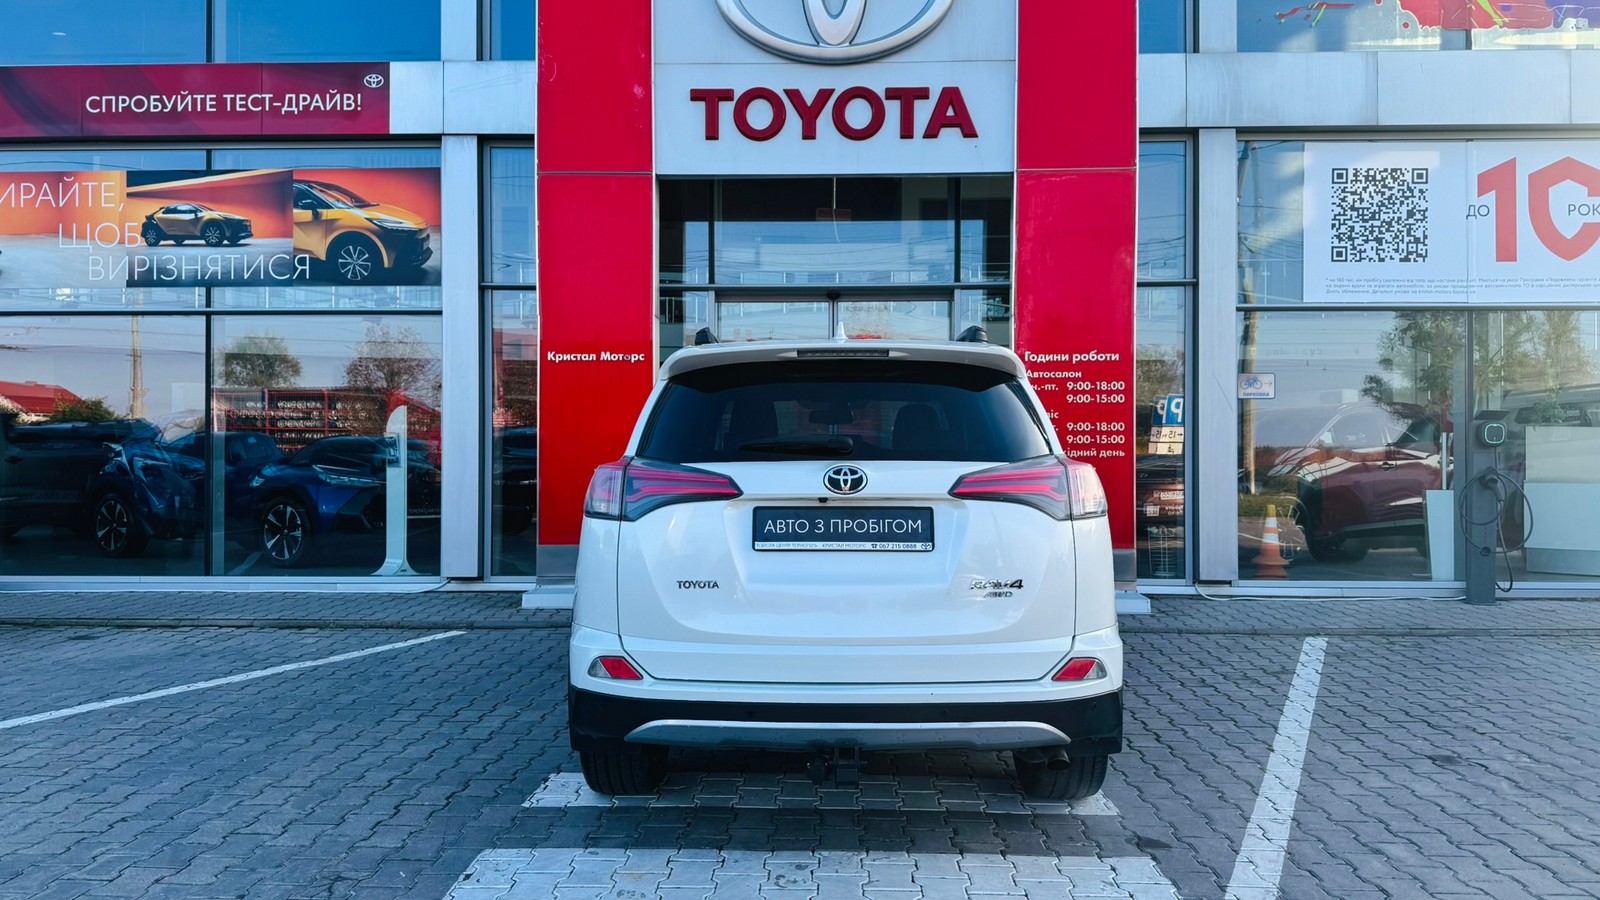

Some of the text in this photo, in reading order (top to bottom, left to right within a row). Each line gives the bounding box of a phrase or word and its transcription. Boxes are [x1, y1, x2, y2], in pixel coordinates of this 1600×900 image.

[85, 89, 362, 115] СПРОБУЙТЕ ТЕСТ-ДРАЙВ!
[690, 86, 979, 141] TOYOTA
[1465, 204, 1490, 220] ДО
[58, 222, 141, 253] ЩОБ
[88, 253, 310, 282] ВИРІЗНЯТИСЯ
[547, 351, 645, 363] Кристал Моторс
[1024, 350, 1120, 364] Години роботи
[1026, 370, 1082, 378] Автосалон
[1066, 381, 1125, 391] 9:00-18:00
[1066, 394, 1125, 404] 9:00-15:00
[1066, 422, 1125, 432] 9:00-18:00
[1066, 435, 1125, 444] 9:00-15:00
[1100, 449, 1125, 458] день
[763, 519, 922, 534] АВТО З ПРОБІГОМ
[676, 580, 720, 589] TOYOTA
